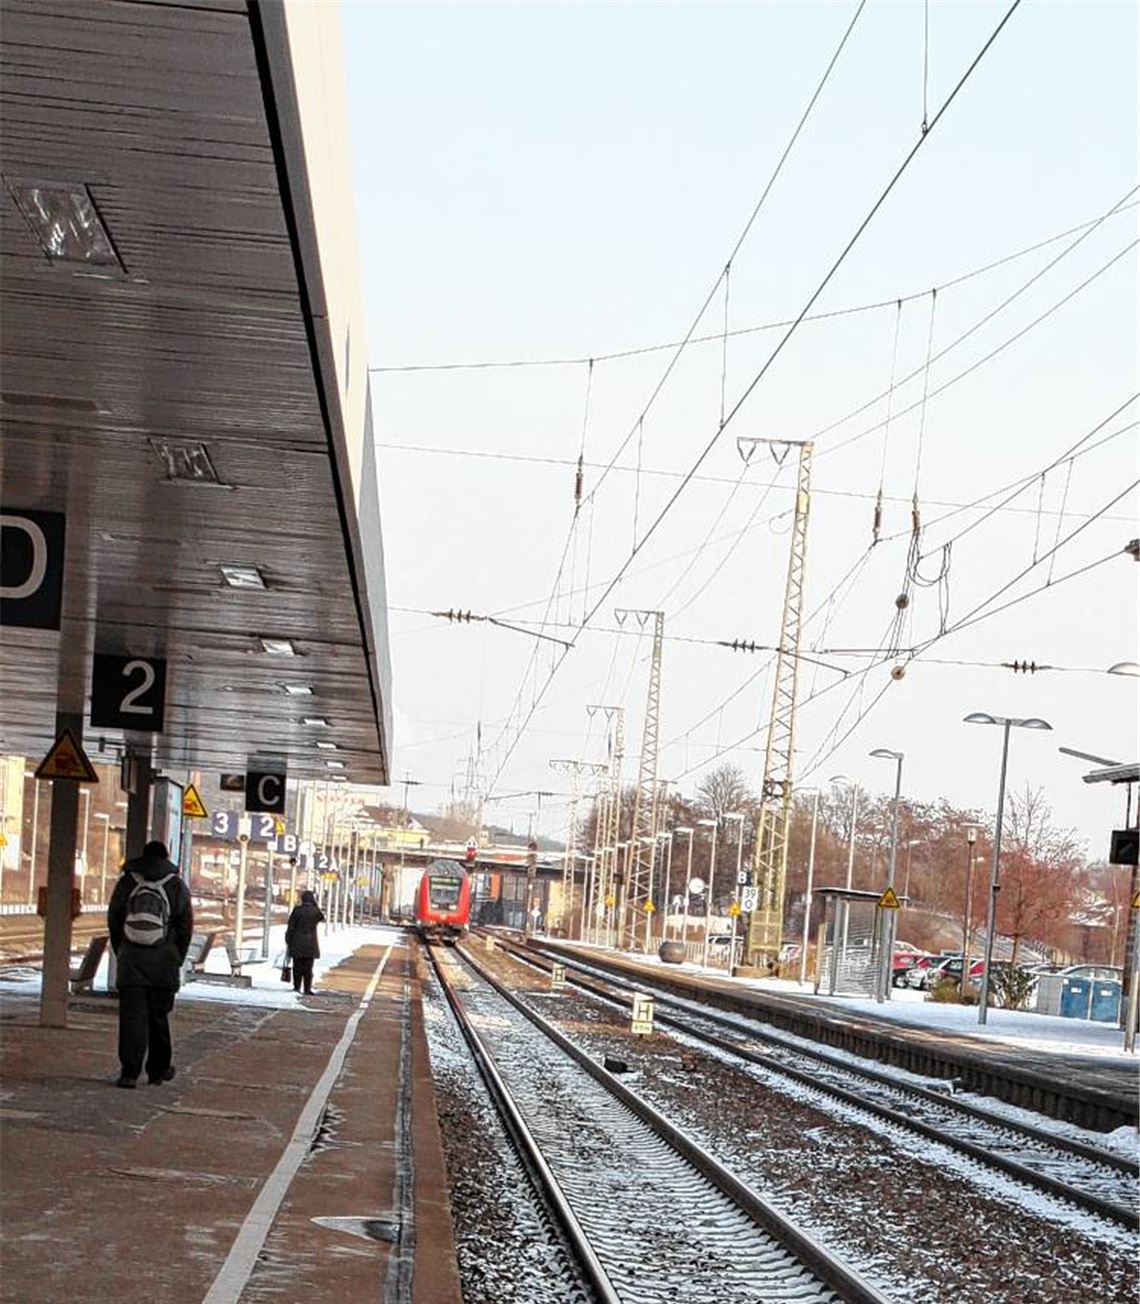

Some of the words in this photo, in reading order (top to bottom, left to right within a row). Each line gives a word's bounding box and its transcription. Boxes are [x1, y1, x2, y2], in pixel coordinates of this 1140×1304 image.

[119, 660, 156, 714] 2
[258, 775, 281, 805] C
[214, 812, 229, 834] 3
[260, 817, 274, 837] 2
[284, 834, 297, 852] B
[637, 1003, 650, 1021] H
